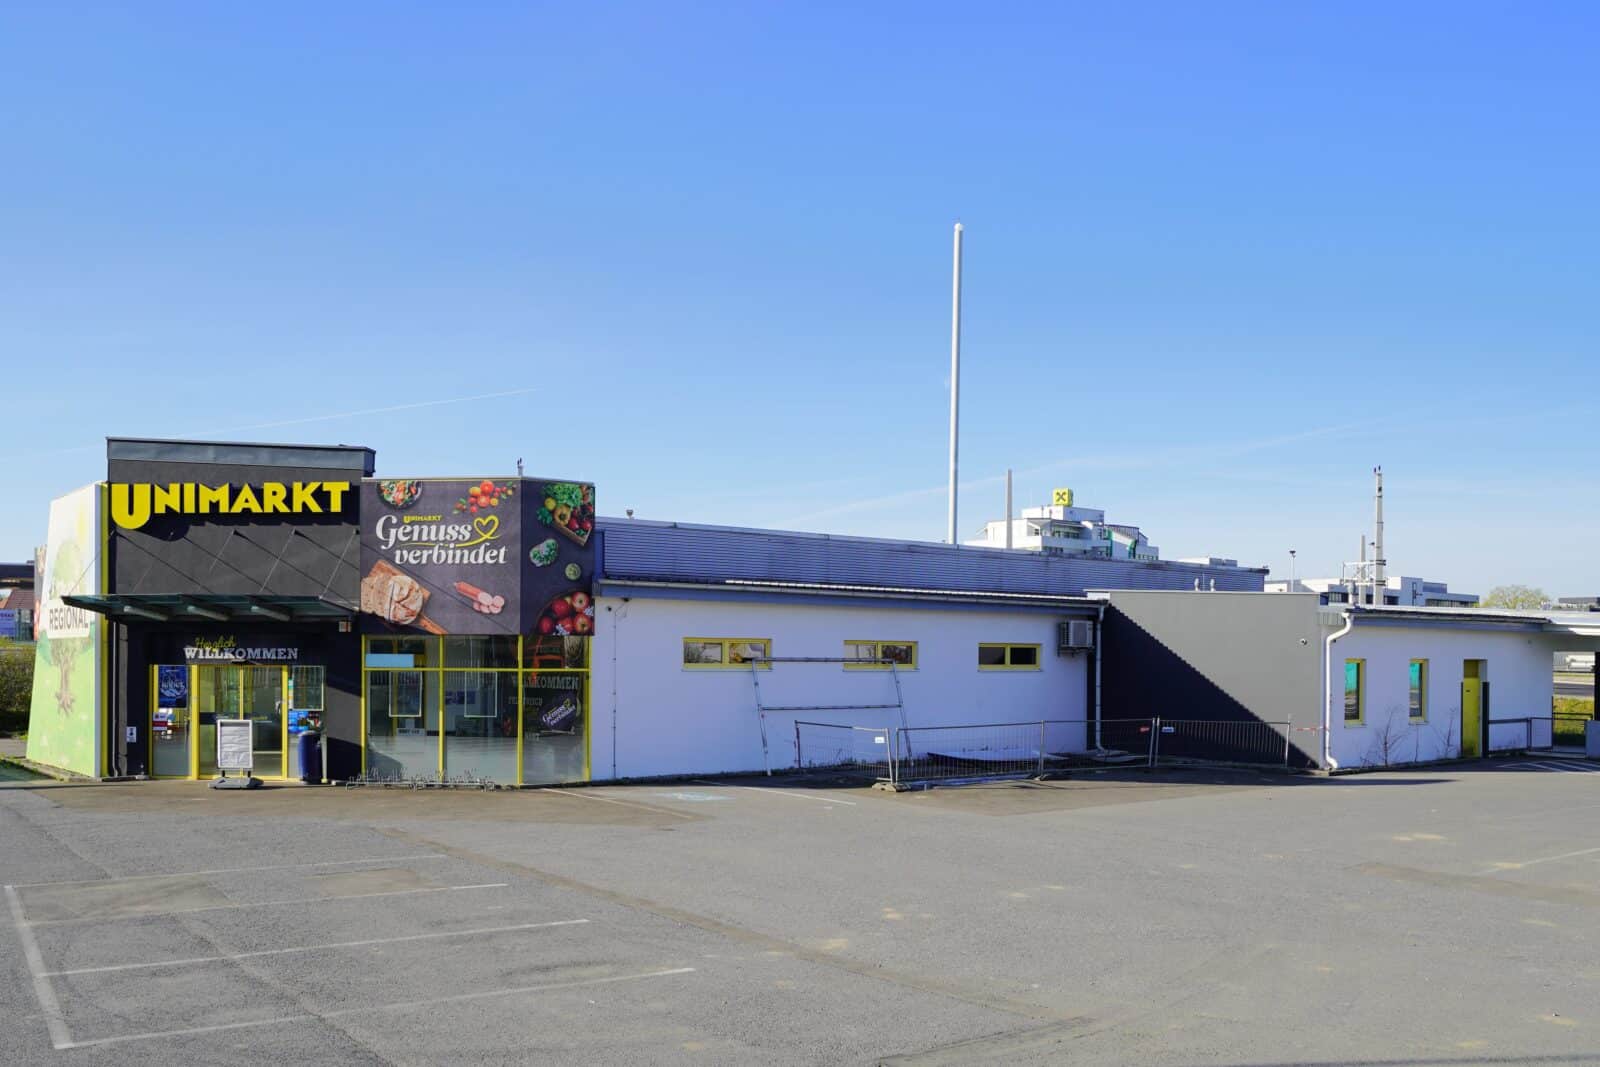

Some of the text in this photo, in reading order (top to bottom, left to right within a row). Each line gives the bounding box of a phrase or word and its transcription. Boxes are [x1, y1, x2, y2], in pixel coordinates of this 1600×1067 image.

[111, 481, 349, 530] UNIMARKT
[375, 514, 472, 549] Genuss
[394, 543, 507, 564] verbindet
[49, 607, 89, 632] REGIONAL
[183, 645, 298, 659] WILLKOMMEN
